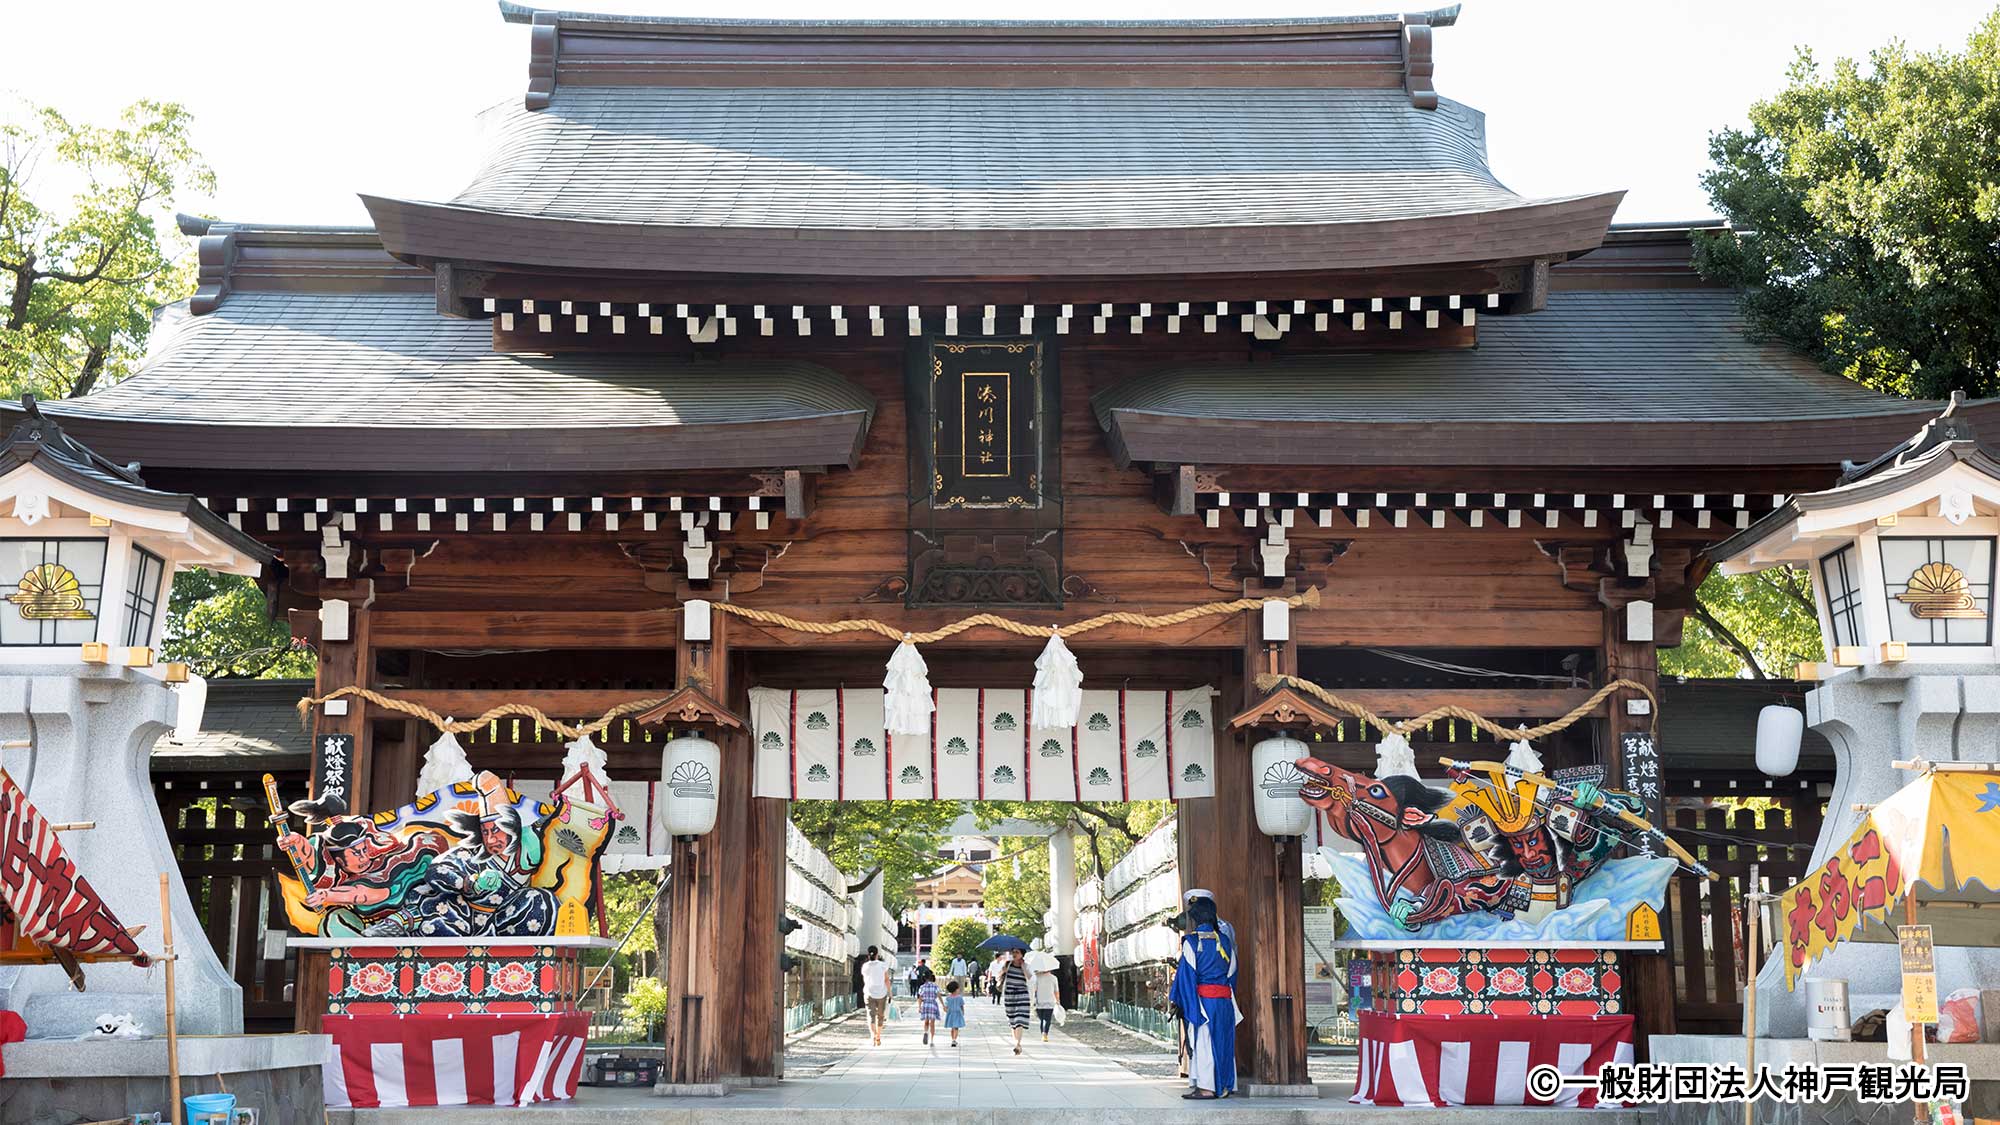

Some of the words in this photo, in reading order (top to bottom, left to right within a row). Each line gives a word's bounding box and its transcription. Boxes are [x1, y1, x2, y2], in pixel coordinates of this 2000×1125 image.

[976, 383, 998, 465] 湊川神社
[1638, 738, 1659, 799] 献燈祭
[0, 792, 140, 955] ビーカステ
